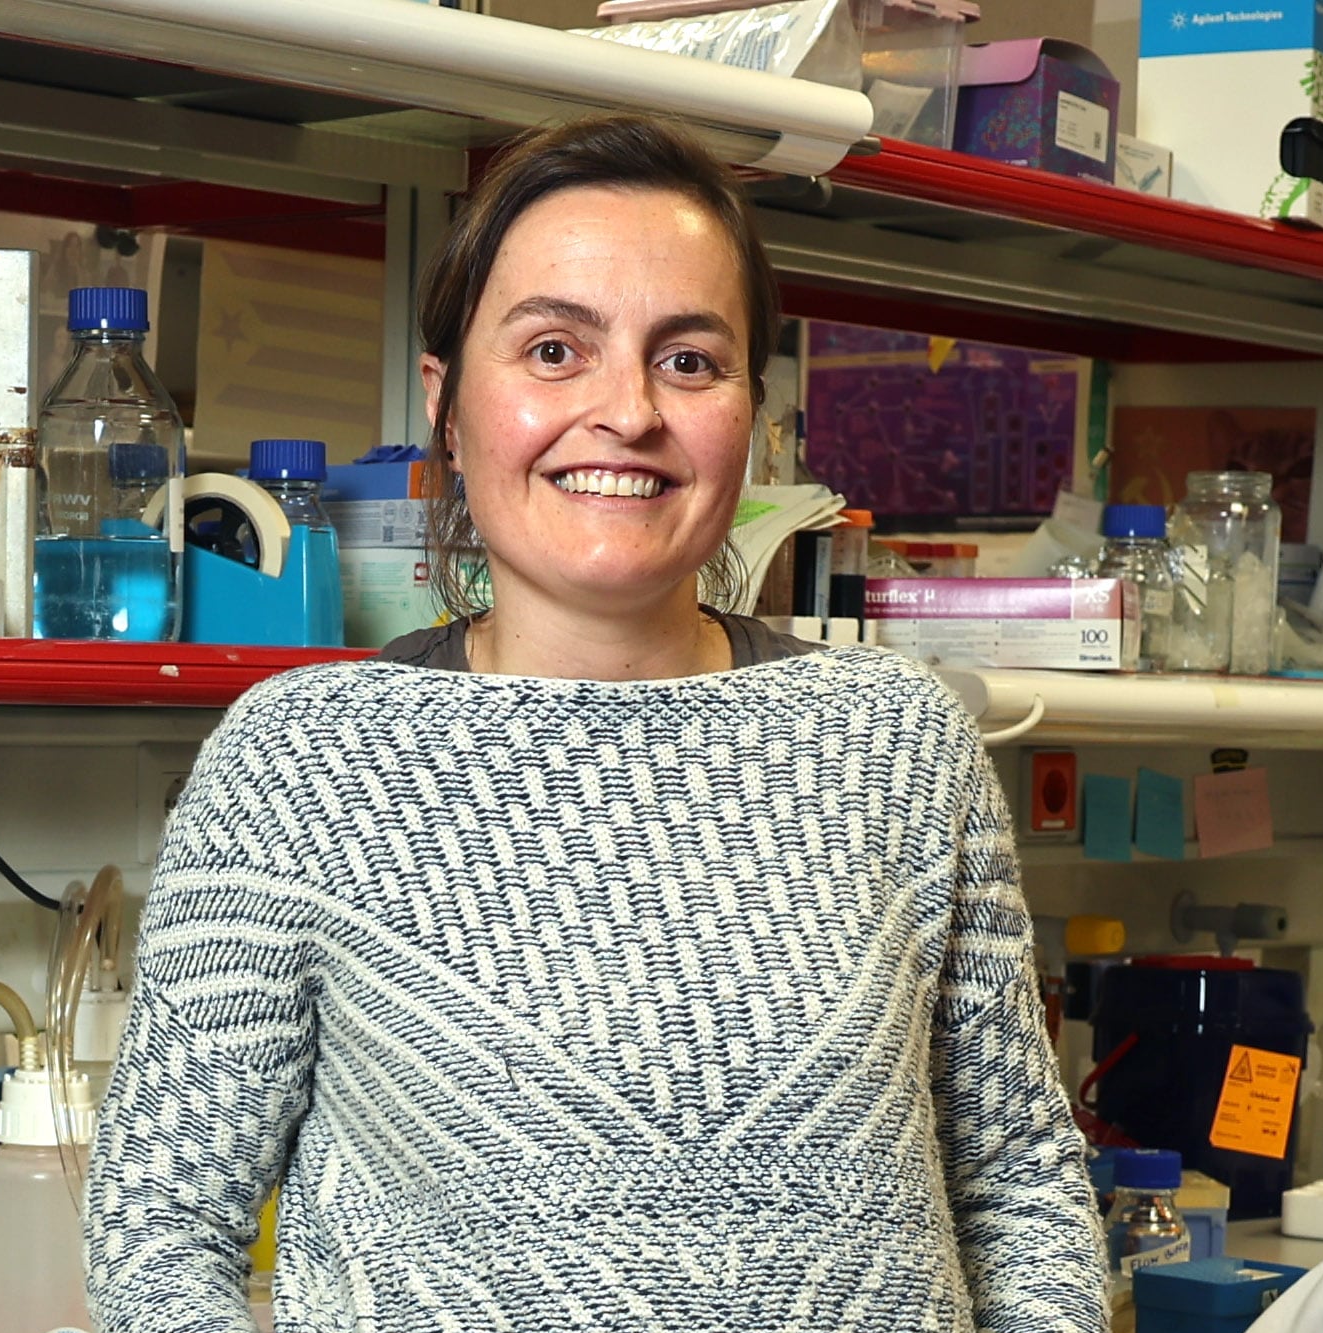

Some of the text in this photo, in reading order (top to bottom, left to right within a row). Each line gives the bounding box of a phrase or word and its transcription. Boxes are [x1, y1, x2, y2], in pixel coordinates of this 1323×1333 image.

[1192, 10, 1283, 25] Agilent Technologies
[865, 590, 917, 604] turflex
[1085, 590, 1110, 604] XS
[1080, 629, 1108, 644] 100
